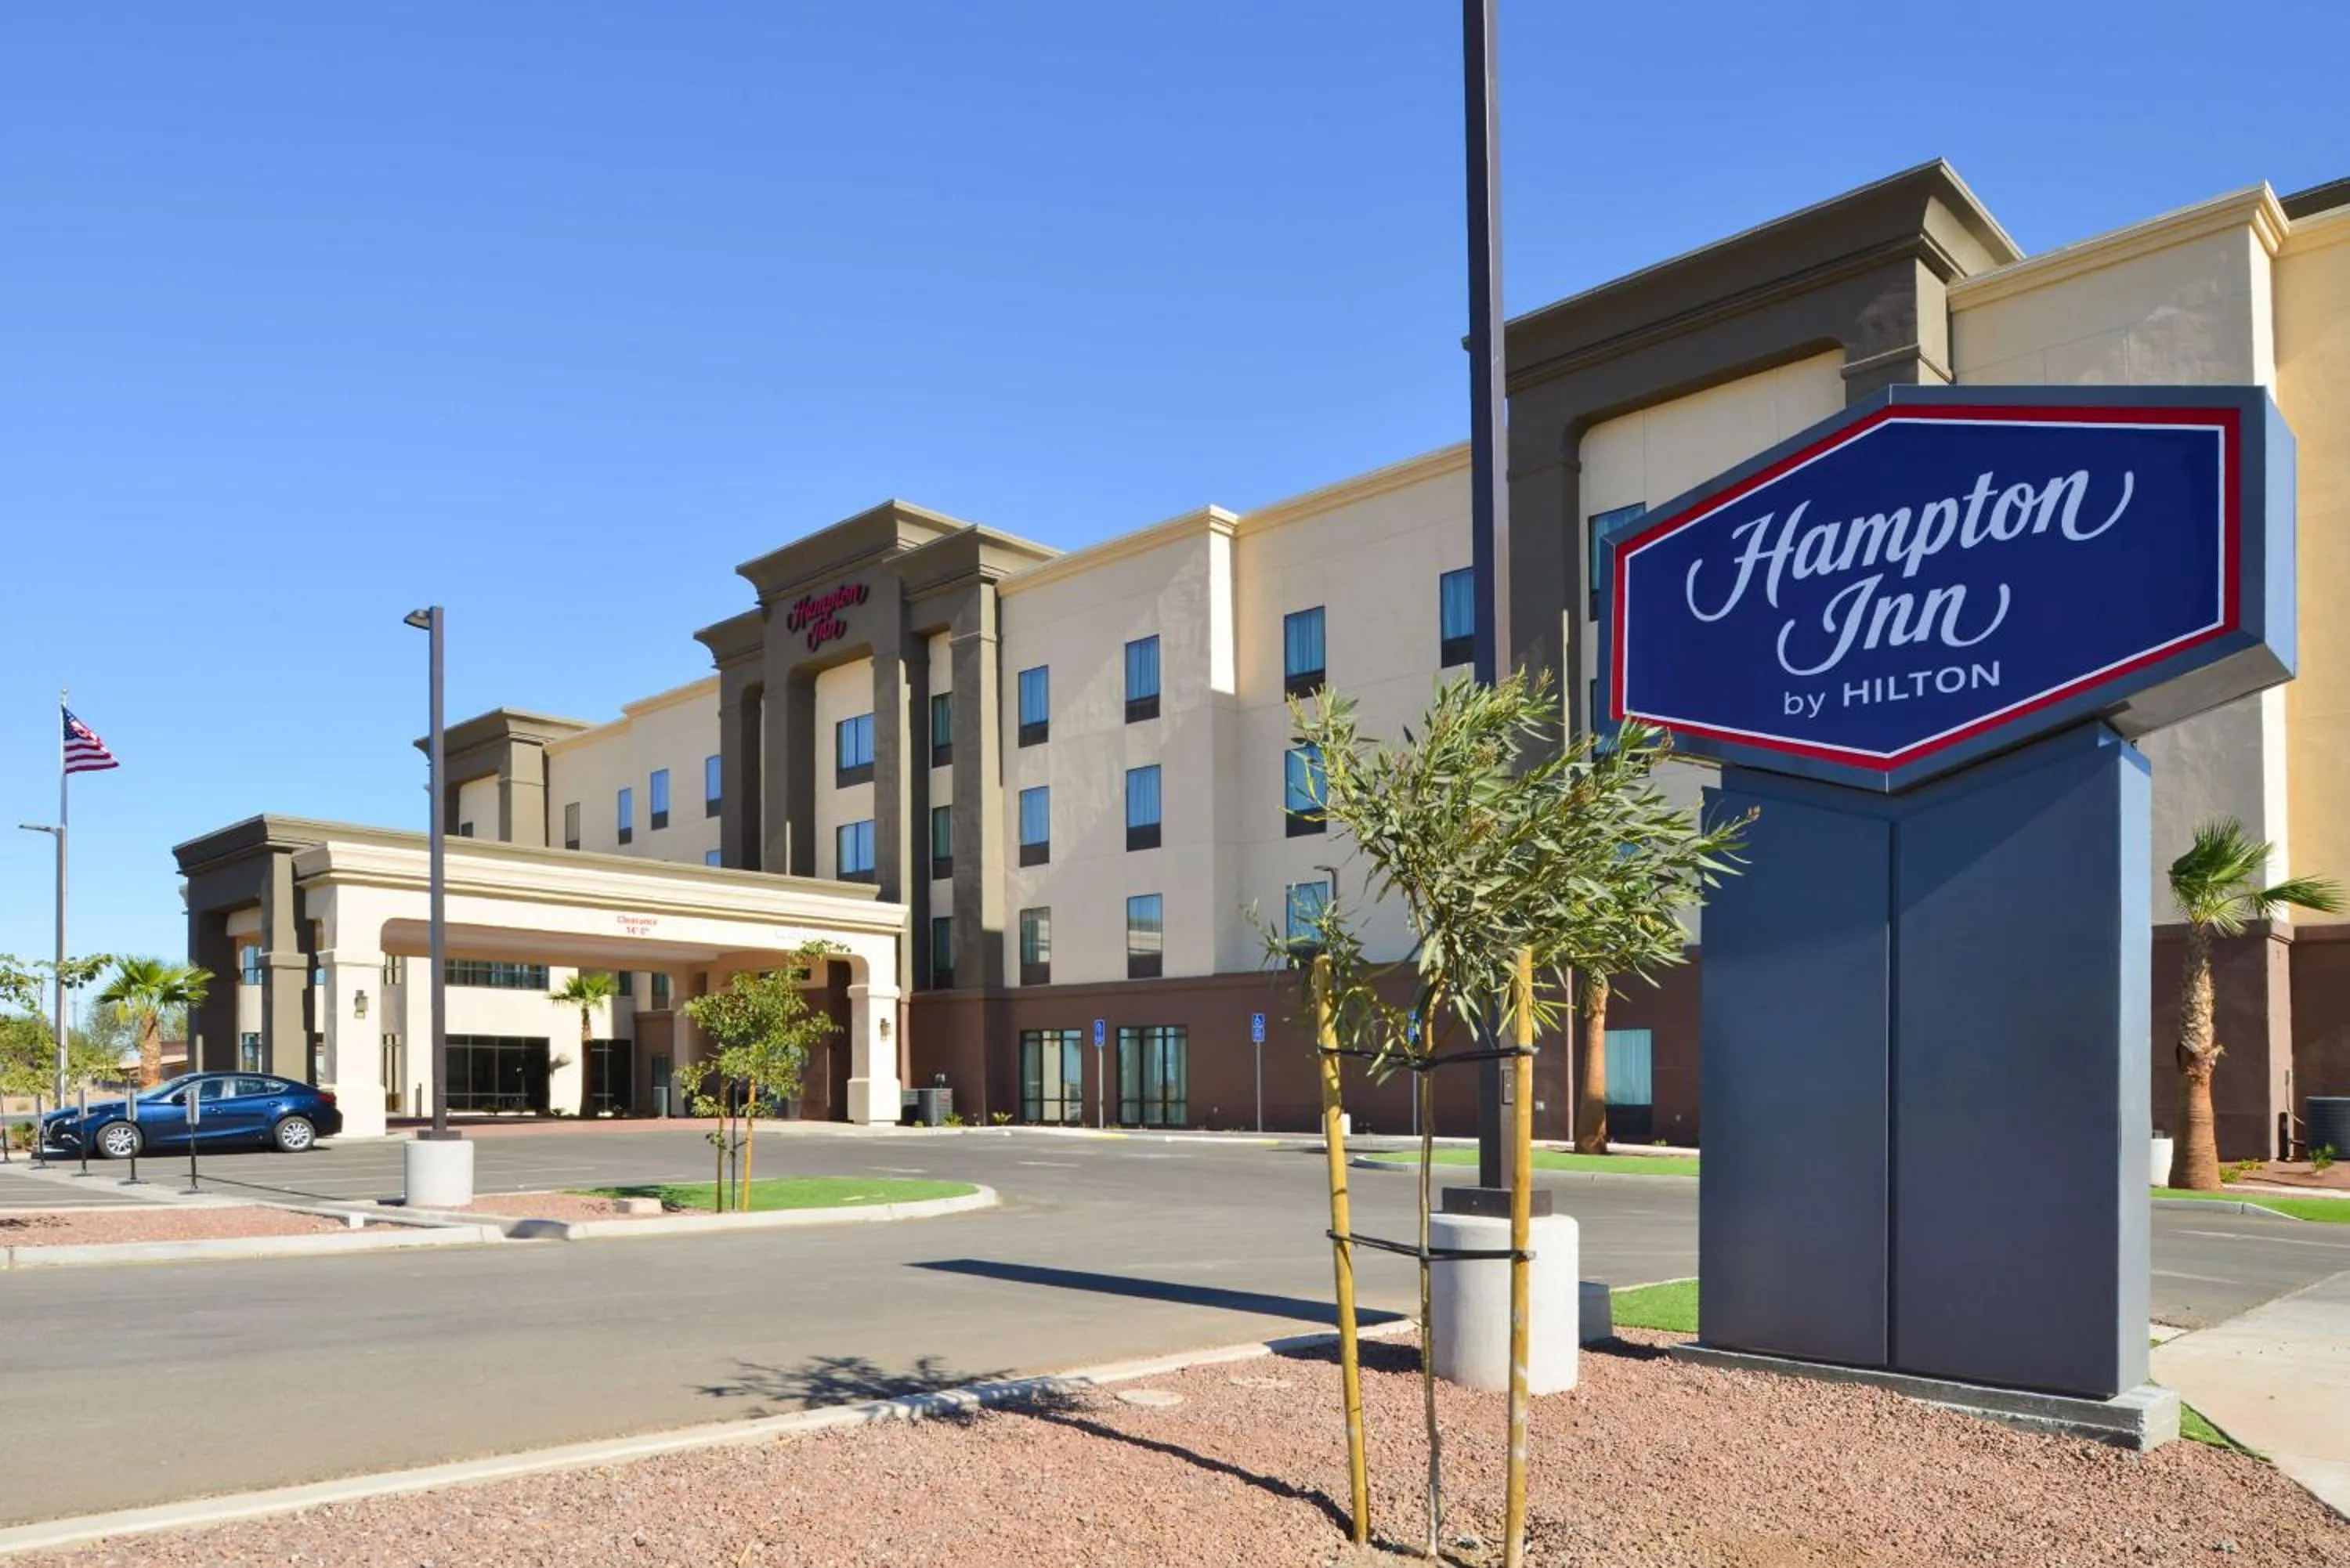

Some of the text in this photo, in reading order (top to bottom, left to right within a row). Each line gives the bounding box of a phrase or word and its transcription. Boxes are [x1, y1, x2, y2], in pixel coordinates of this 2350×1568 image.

[1687, 469, 2135, 621] Hampton
[786, 583, 870, 634] Hampton
[807, 617, 848, 652] Inn
[1777, 573, 2010, 676] Inn
[1784, 661, 2000, 718] by HILTON
